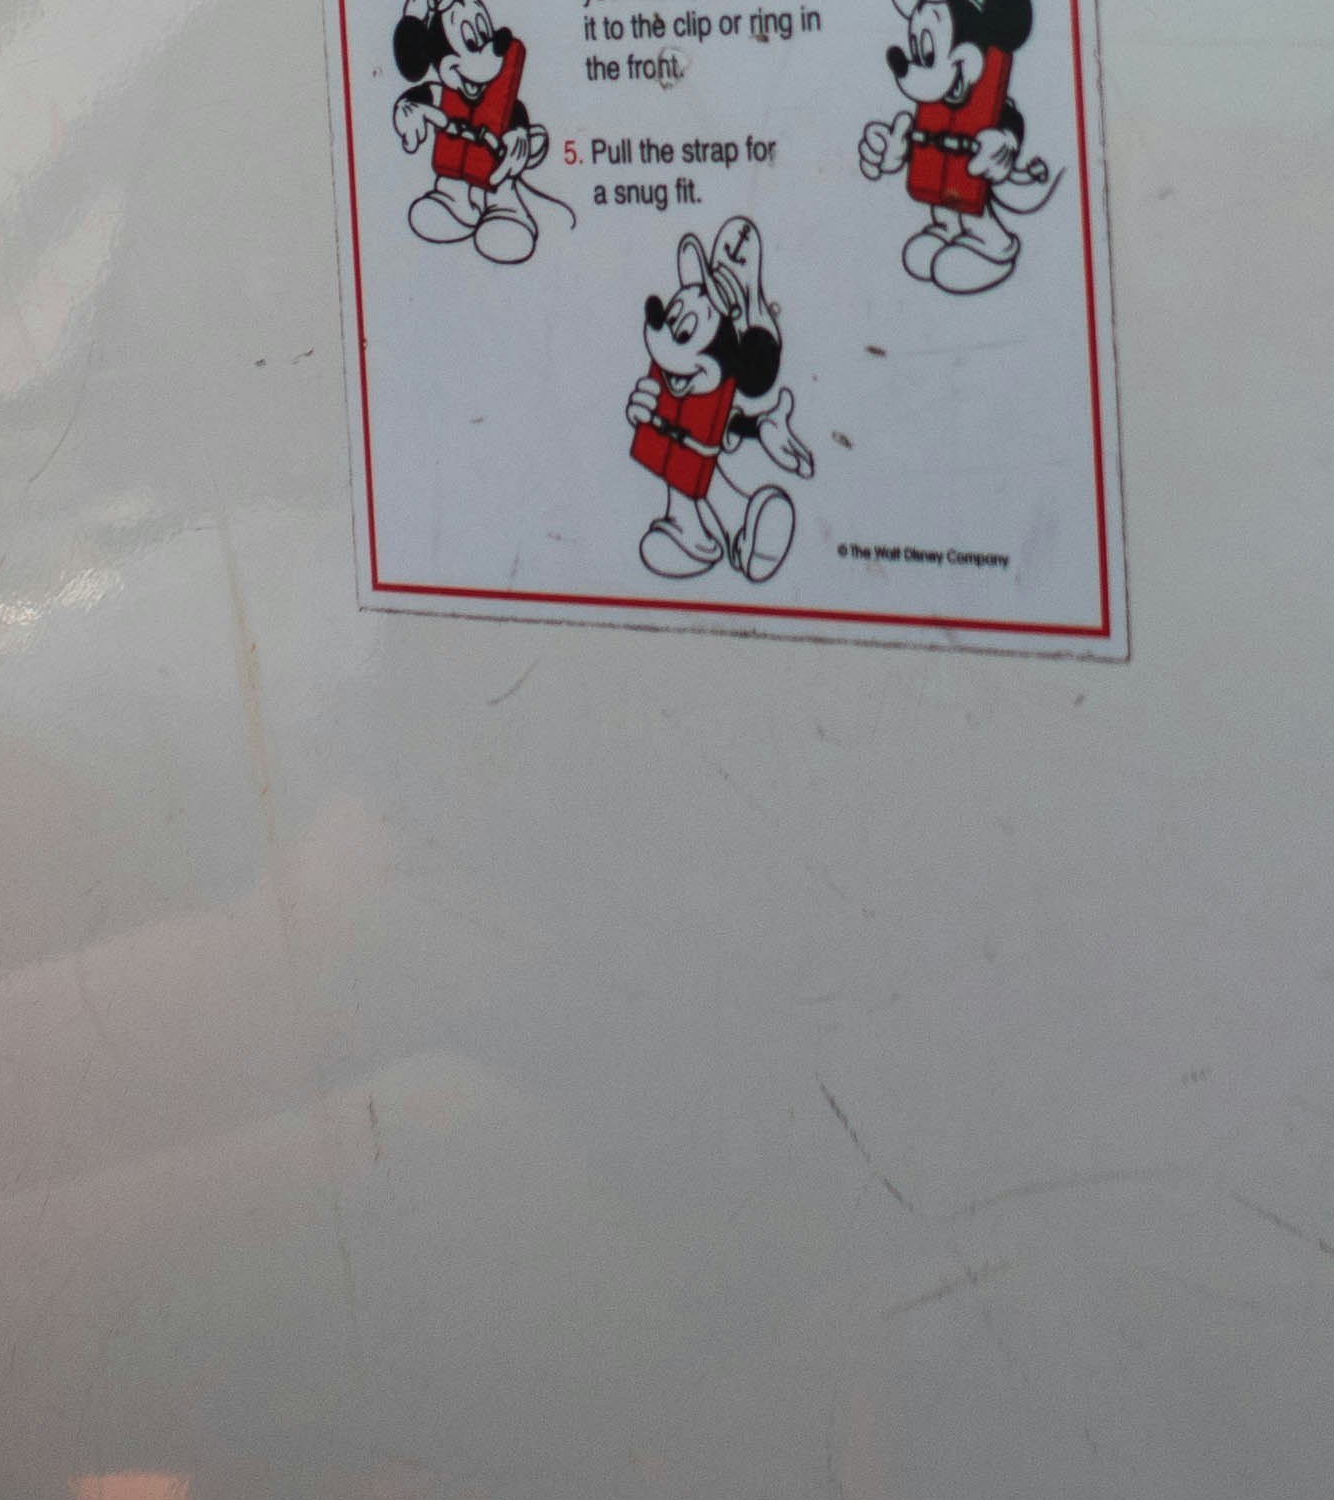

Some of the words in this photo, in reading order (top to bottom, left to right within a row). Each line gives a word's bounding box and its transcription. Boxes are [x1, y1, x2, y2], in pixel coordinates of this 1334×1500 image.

[584, 15, 597, 41] it
[602, 16, 624, 41] to
[630, 12, 666, 39] the
[673, 10, 712, 43] clip
[718, 14, 742, 36] or
[749, 7, 793, 43] ring
[800, 5, 821, 32] in
[585, 55, 620, 81] the
[626, 53, 684, 80] front.
[564, 139, 583, 166] 5.
[591, 138, 632, 165] Pull
[639, 138, 675, 164] the
[681, 138, 739, 169] strap
[745, 135, 777, 162] for
[593, 184, 608, 206] a
[614, 184, 669, 212] snug
[674, 177, 702, 204] fit.
[850, 543, 871, 560] The
[946, 548, 1009, 568] Company
